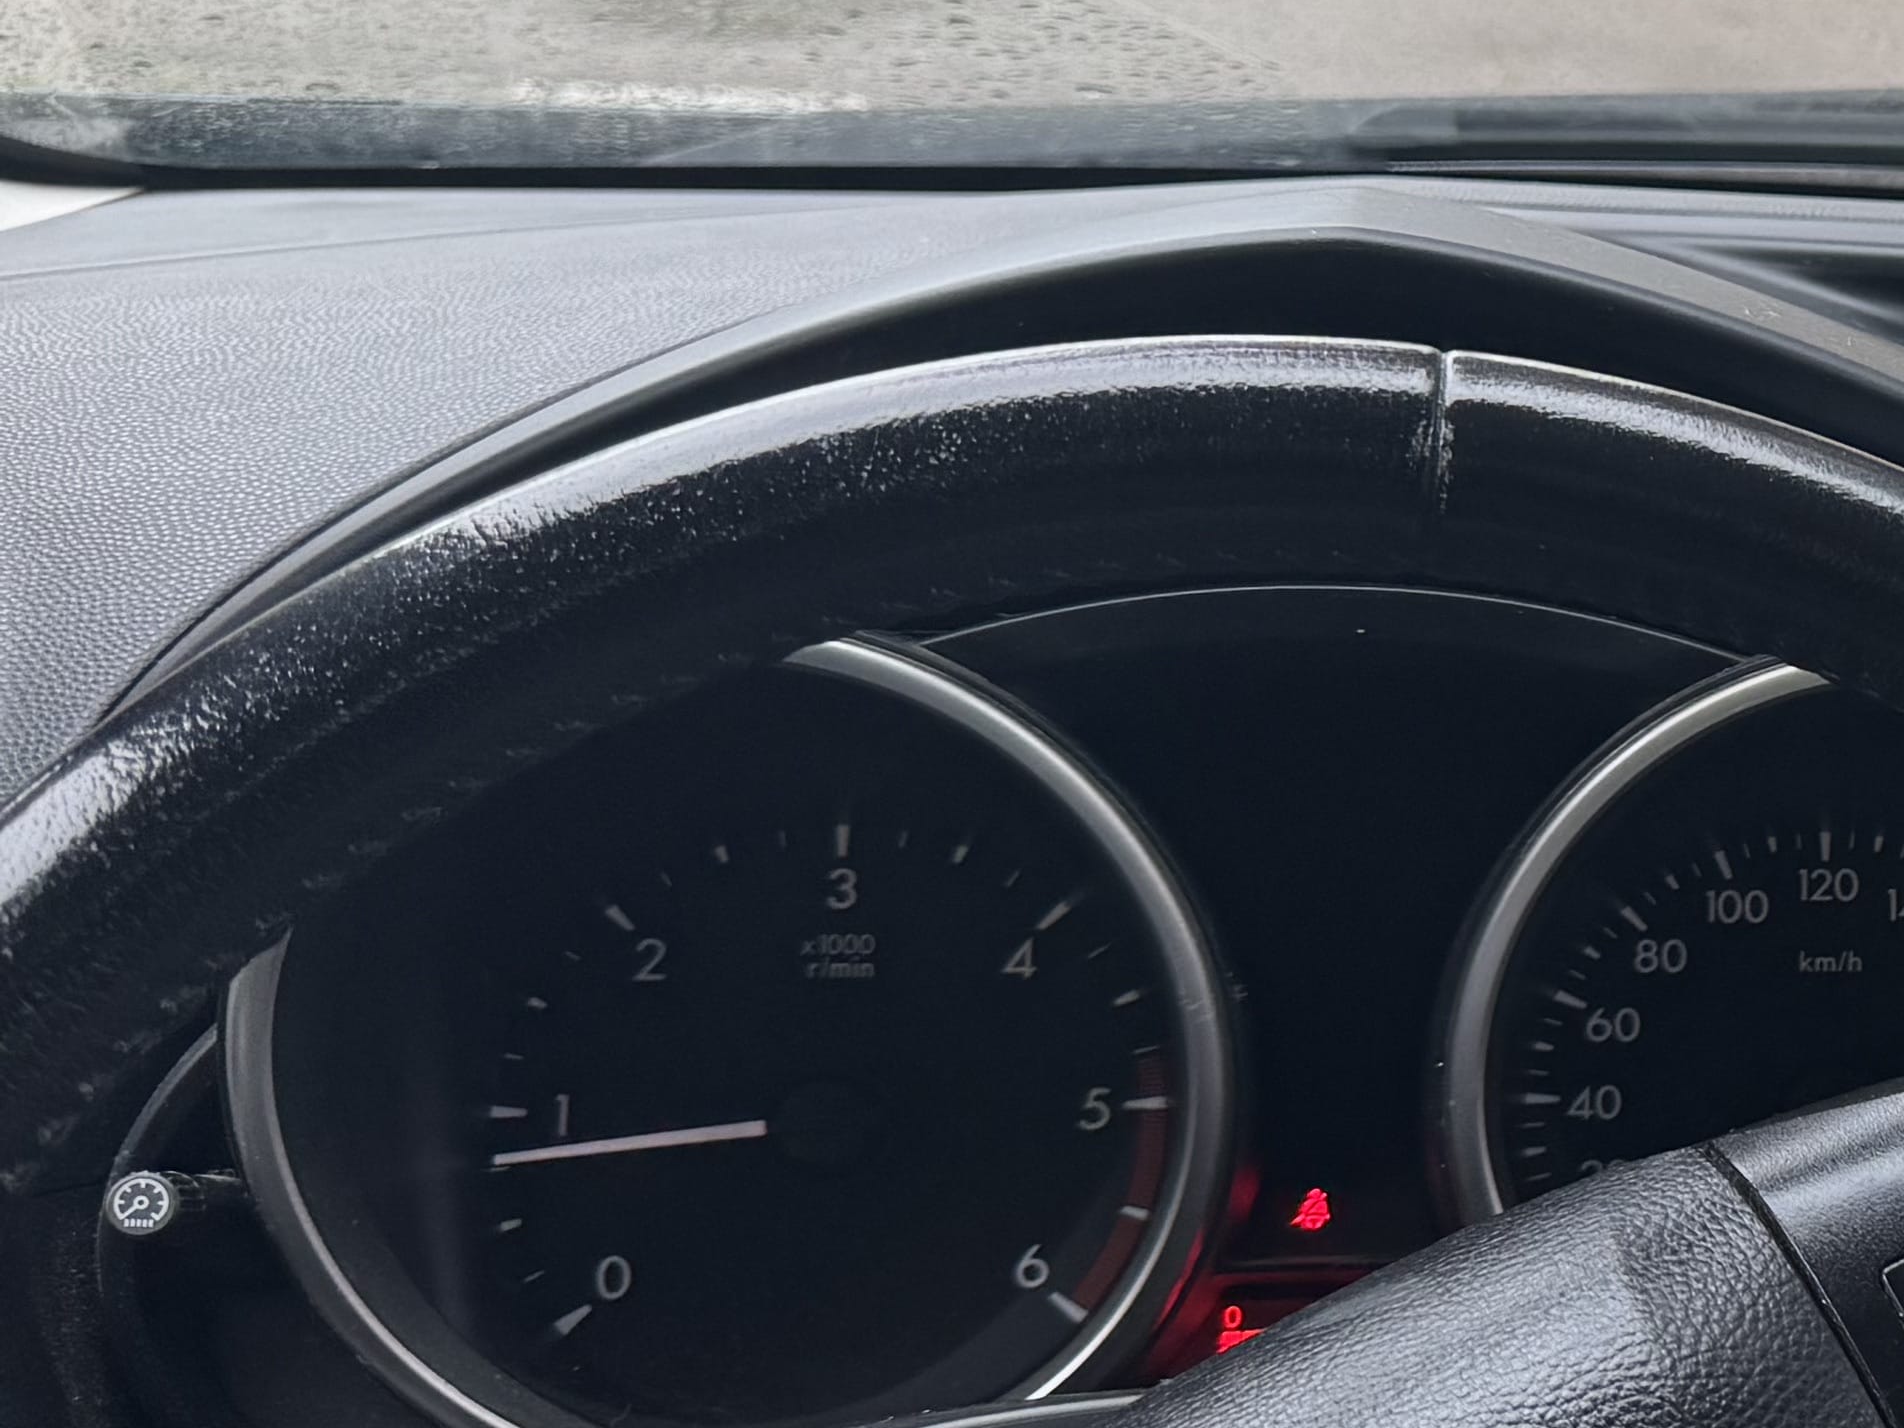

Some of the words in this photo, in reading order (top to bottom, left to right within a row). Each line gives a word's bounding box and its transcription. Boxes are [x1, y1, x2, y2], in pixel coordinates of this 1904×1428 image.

[826, 868, 858, 910] 3
[1800, 869, 1858, 902] 120
[1707, 889, 1768, 924] 100
[633, 938, 667, 982] 2
[801, 933, 876, 956] x1000
[1000, 939, 1037, 979] 4
[1635, 939, 1688, 974] 80
[1800, 950, 1862, 976] km/h
[1586, 1007, 1641, 1044] 60
[554, 1094, 571, 1136] 1
[1078, 1087, 1111, 1129] 5
[1568, 1084, 1621, 1121] 40
[597, 1254, 632, 1301] 0
[1014, 1242, 1050, 1289] 6
